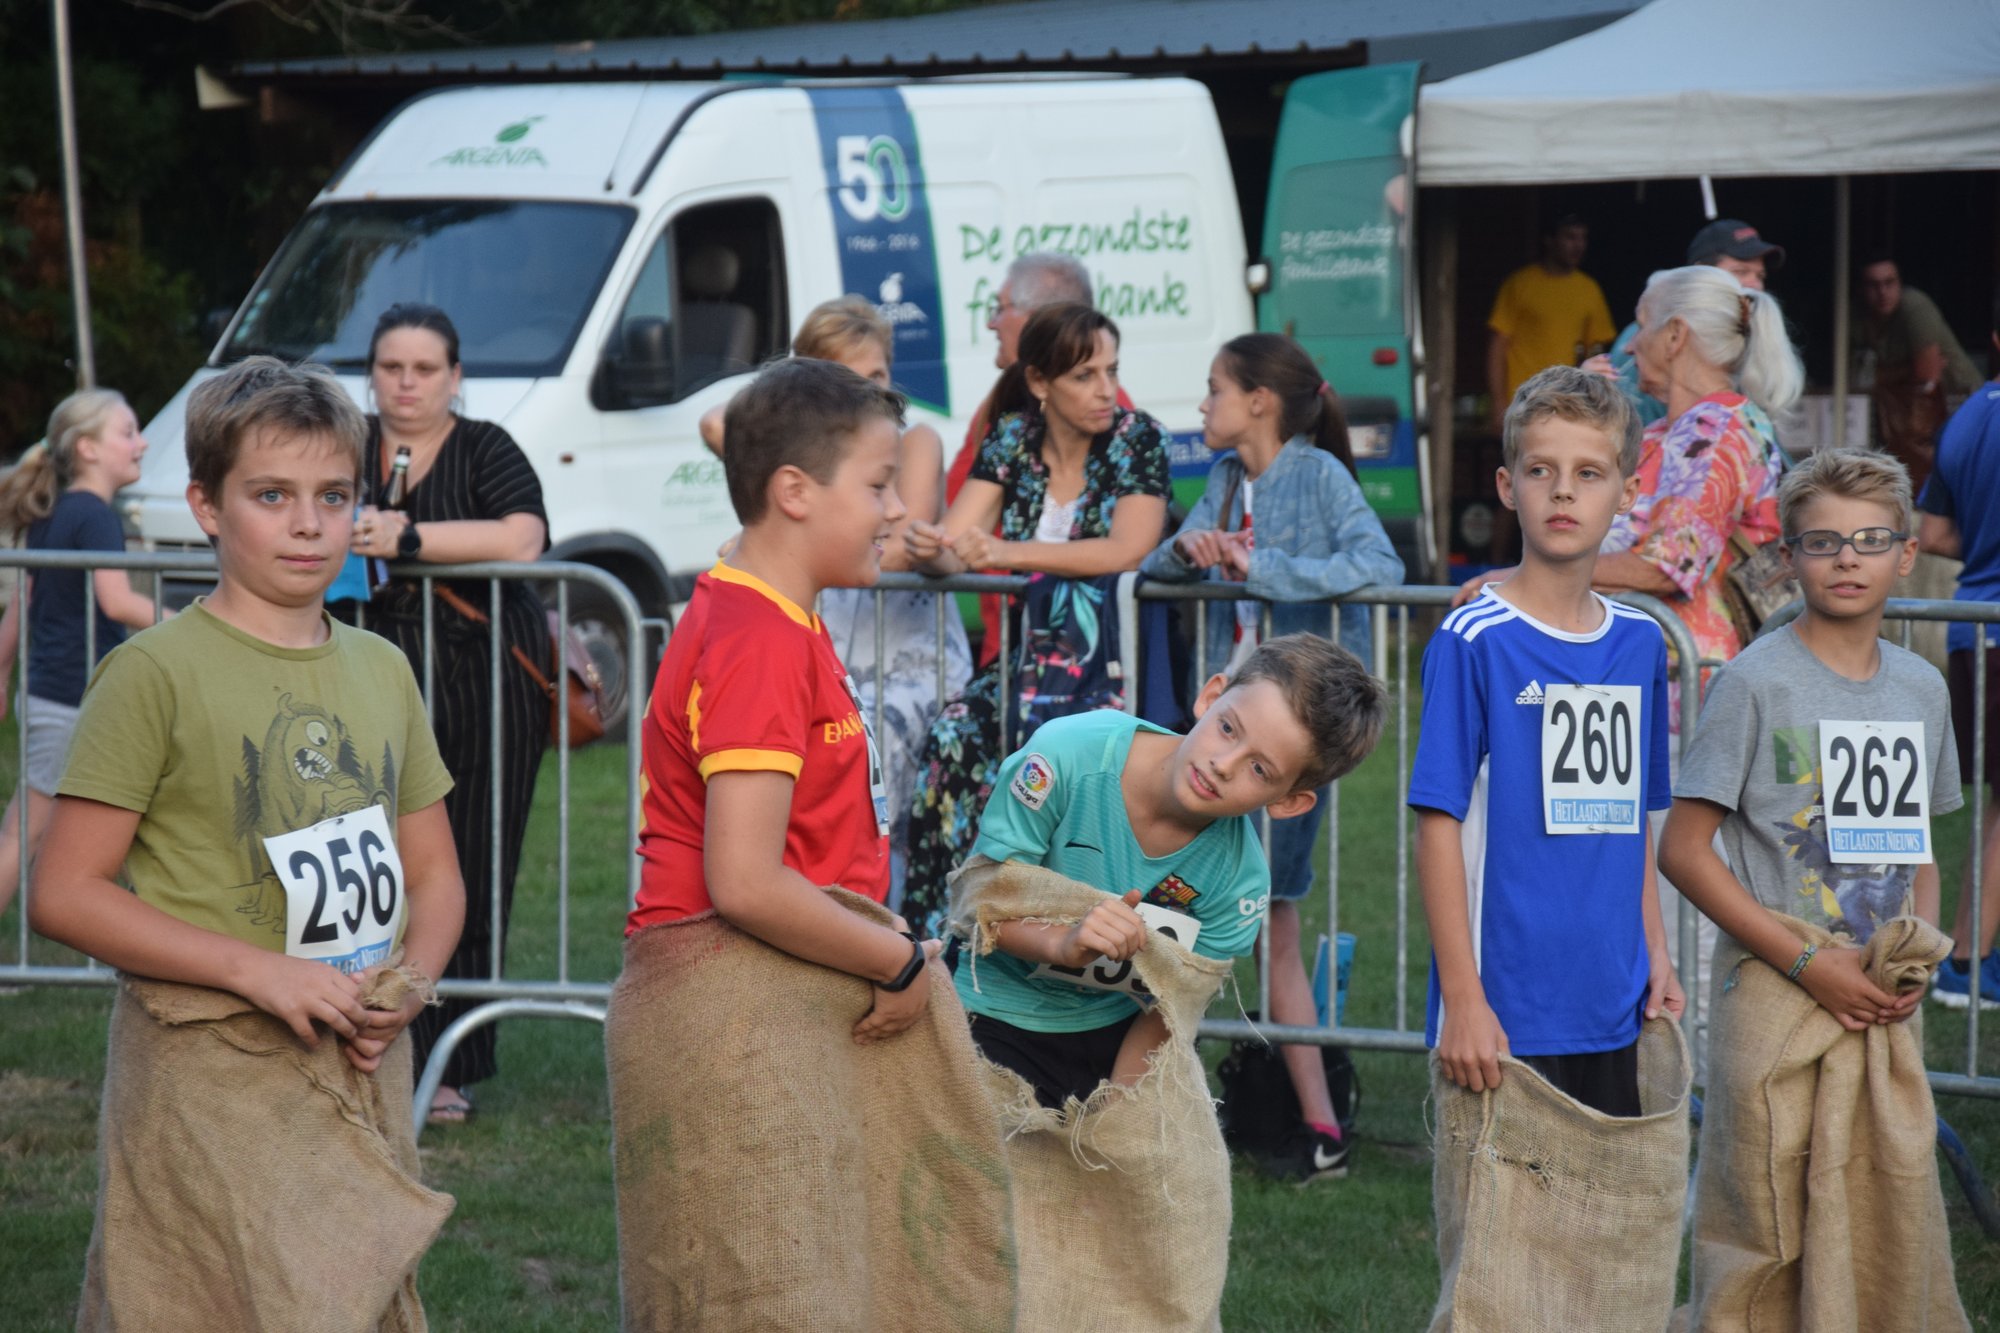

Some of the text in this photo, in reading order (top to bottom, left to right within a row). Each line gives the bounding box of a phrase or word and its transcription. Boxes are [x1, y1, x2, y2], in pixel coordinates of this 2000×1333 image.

[837, 135, 910, 221] 50
[959, 222, 1002, 262] De
[663, 460, 725, 487] ARGE
[1515, 696, 1545, 705] adida
[1551, 700, 1633, 785] 260
[1829, 736, 1921, 818] 262
[1555, 801, 1573, 822] HET
[1573, 801, 1608, 823] LAATSTE
[1833, 830, 1921, 852] HET LAATSTE NIEUWS
[289, 830, 397, 945] 256
